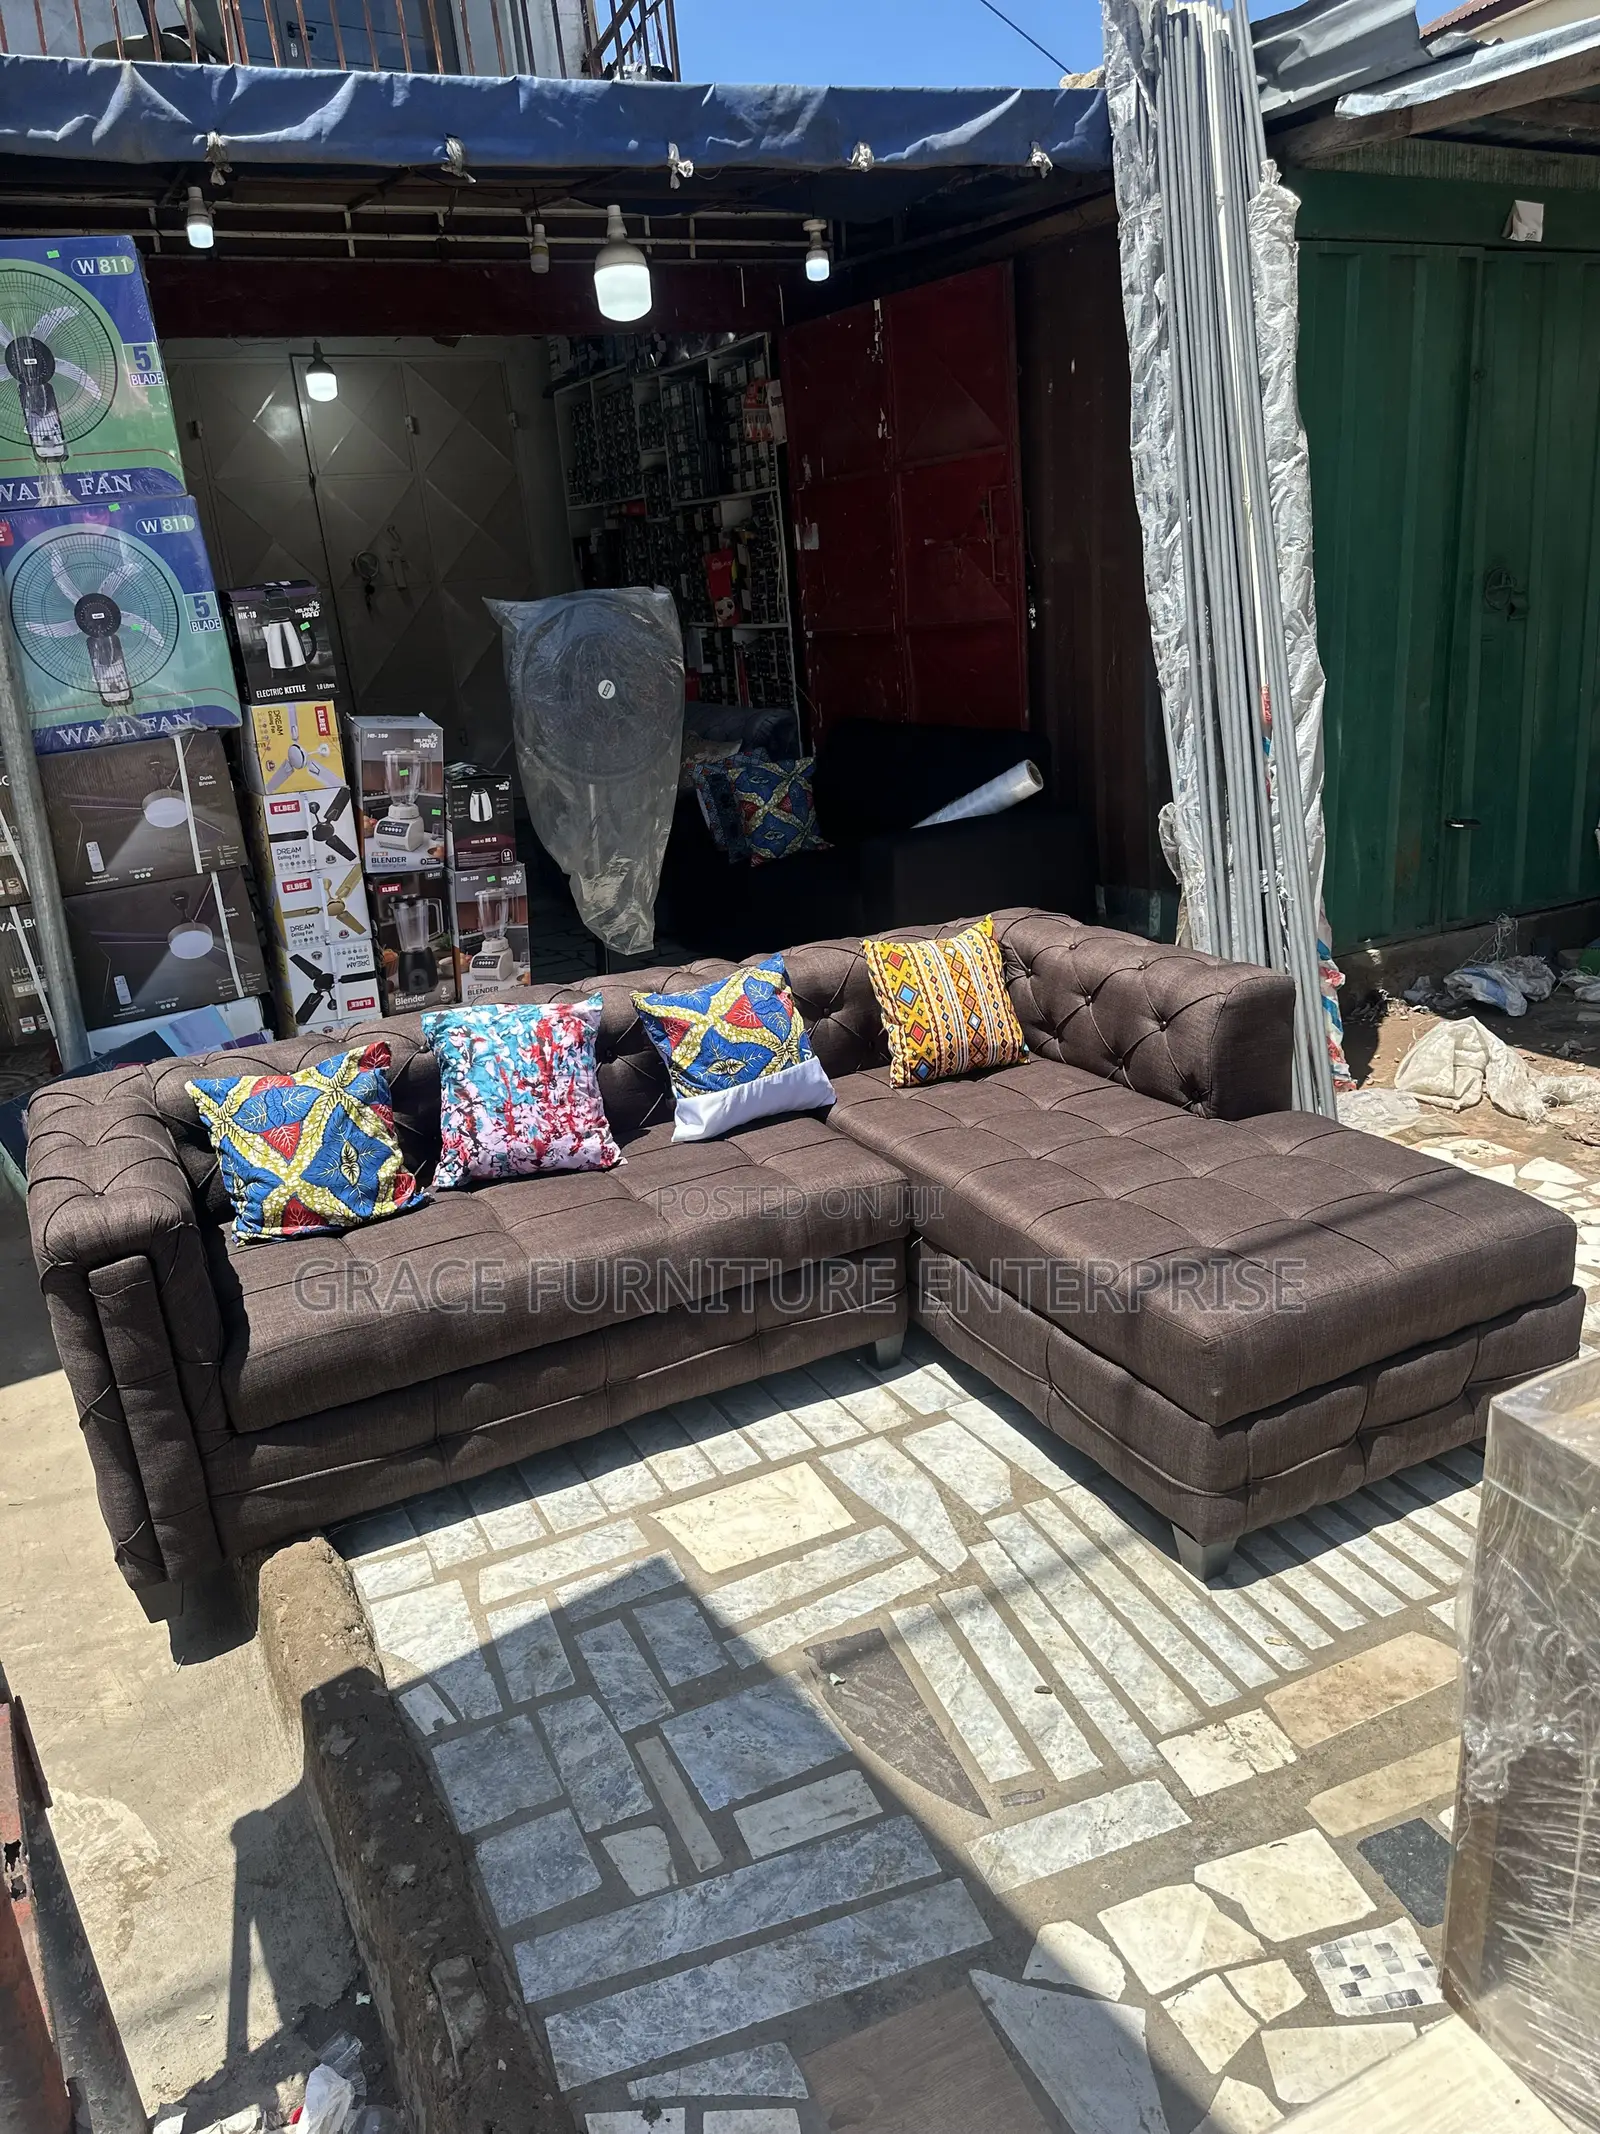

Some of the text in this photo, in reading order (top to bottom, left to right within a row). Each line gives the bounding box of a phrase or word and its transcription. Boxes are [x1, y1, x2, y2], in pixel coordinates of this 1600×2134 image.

[132, 345, 152, 372] 5
[131, 373, 163, 386] BLADE
[77, 473, 134, 497] FAN
[195, 595, 211, 619] 5
[192, 619, 221, 632] BLADE
[256, 684, 307, 699] ELECTRIC KETTLE
[276, 846, 302, 856] DREAM
[371, 856, 407, 864] BLENDER
[290, 923, 315, 932] DREAM
[467, 985, 499, 996] BLENDER
[395, 993, 426, 1006] Blender
